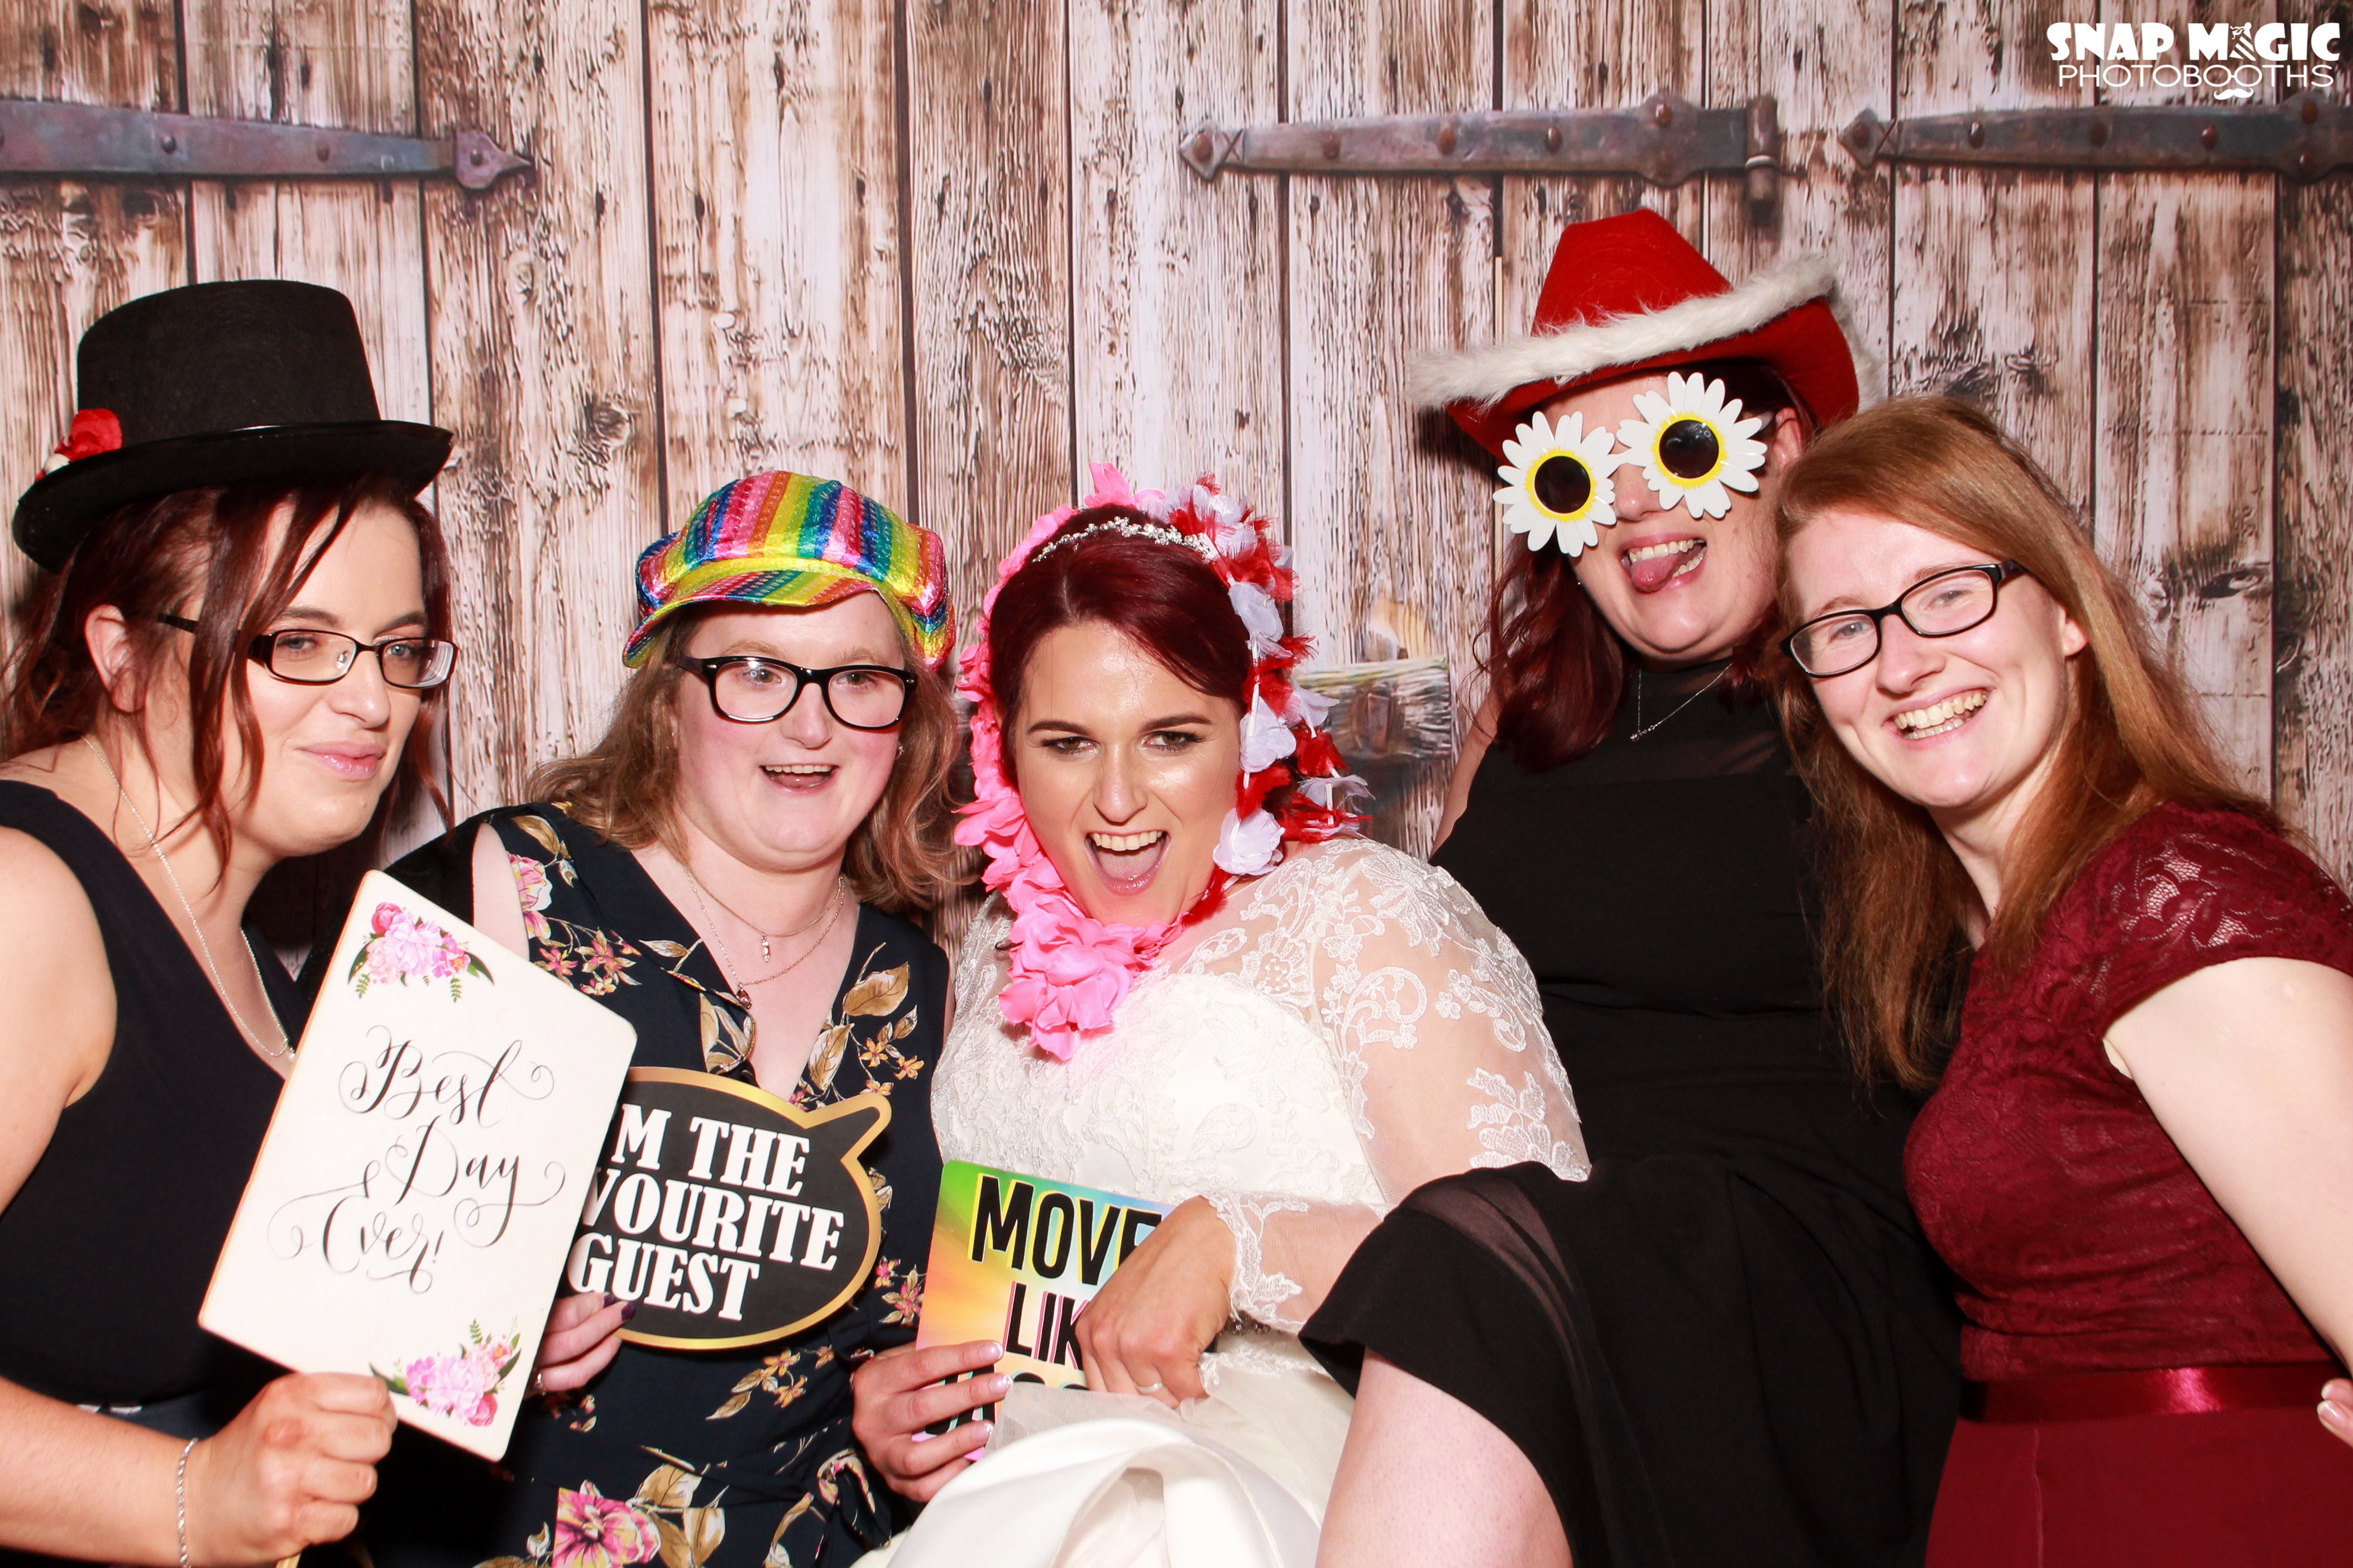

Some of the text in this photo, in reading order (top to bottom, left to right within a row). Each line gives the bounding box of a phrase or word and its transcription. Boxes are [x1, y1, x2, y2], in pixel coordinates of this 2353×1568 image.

[338, 1025, 554, 1128] Best
[385, 1115, 566, 1248] Day
[688, 1116, 811, 1197] THE
[267, 1160, 444, 1294] Ever!
[566, 1232, 761, 1322] GUEST
